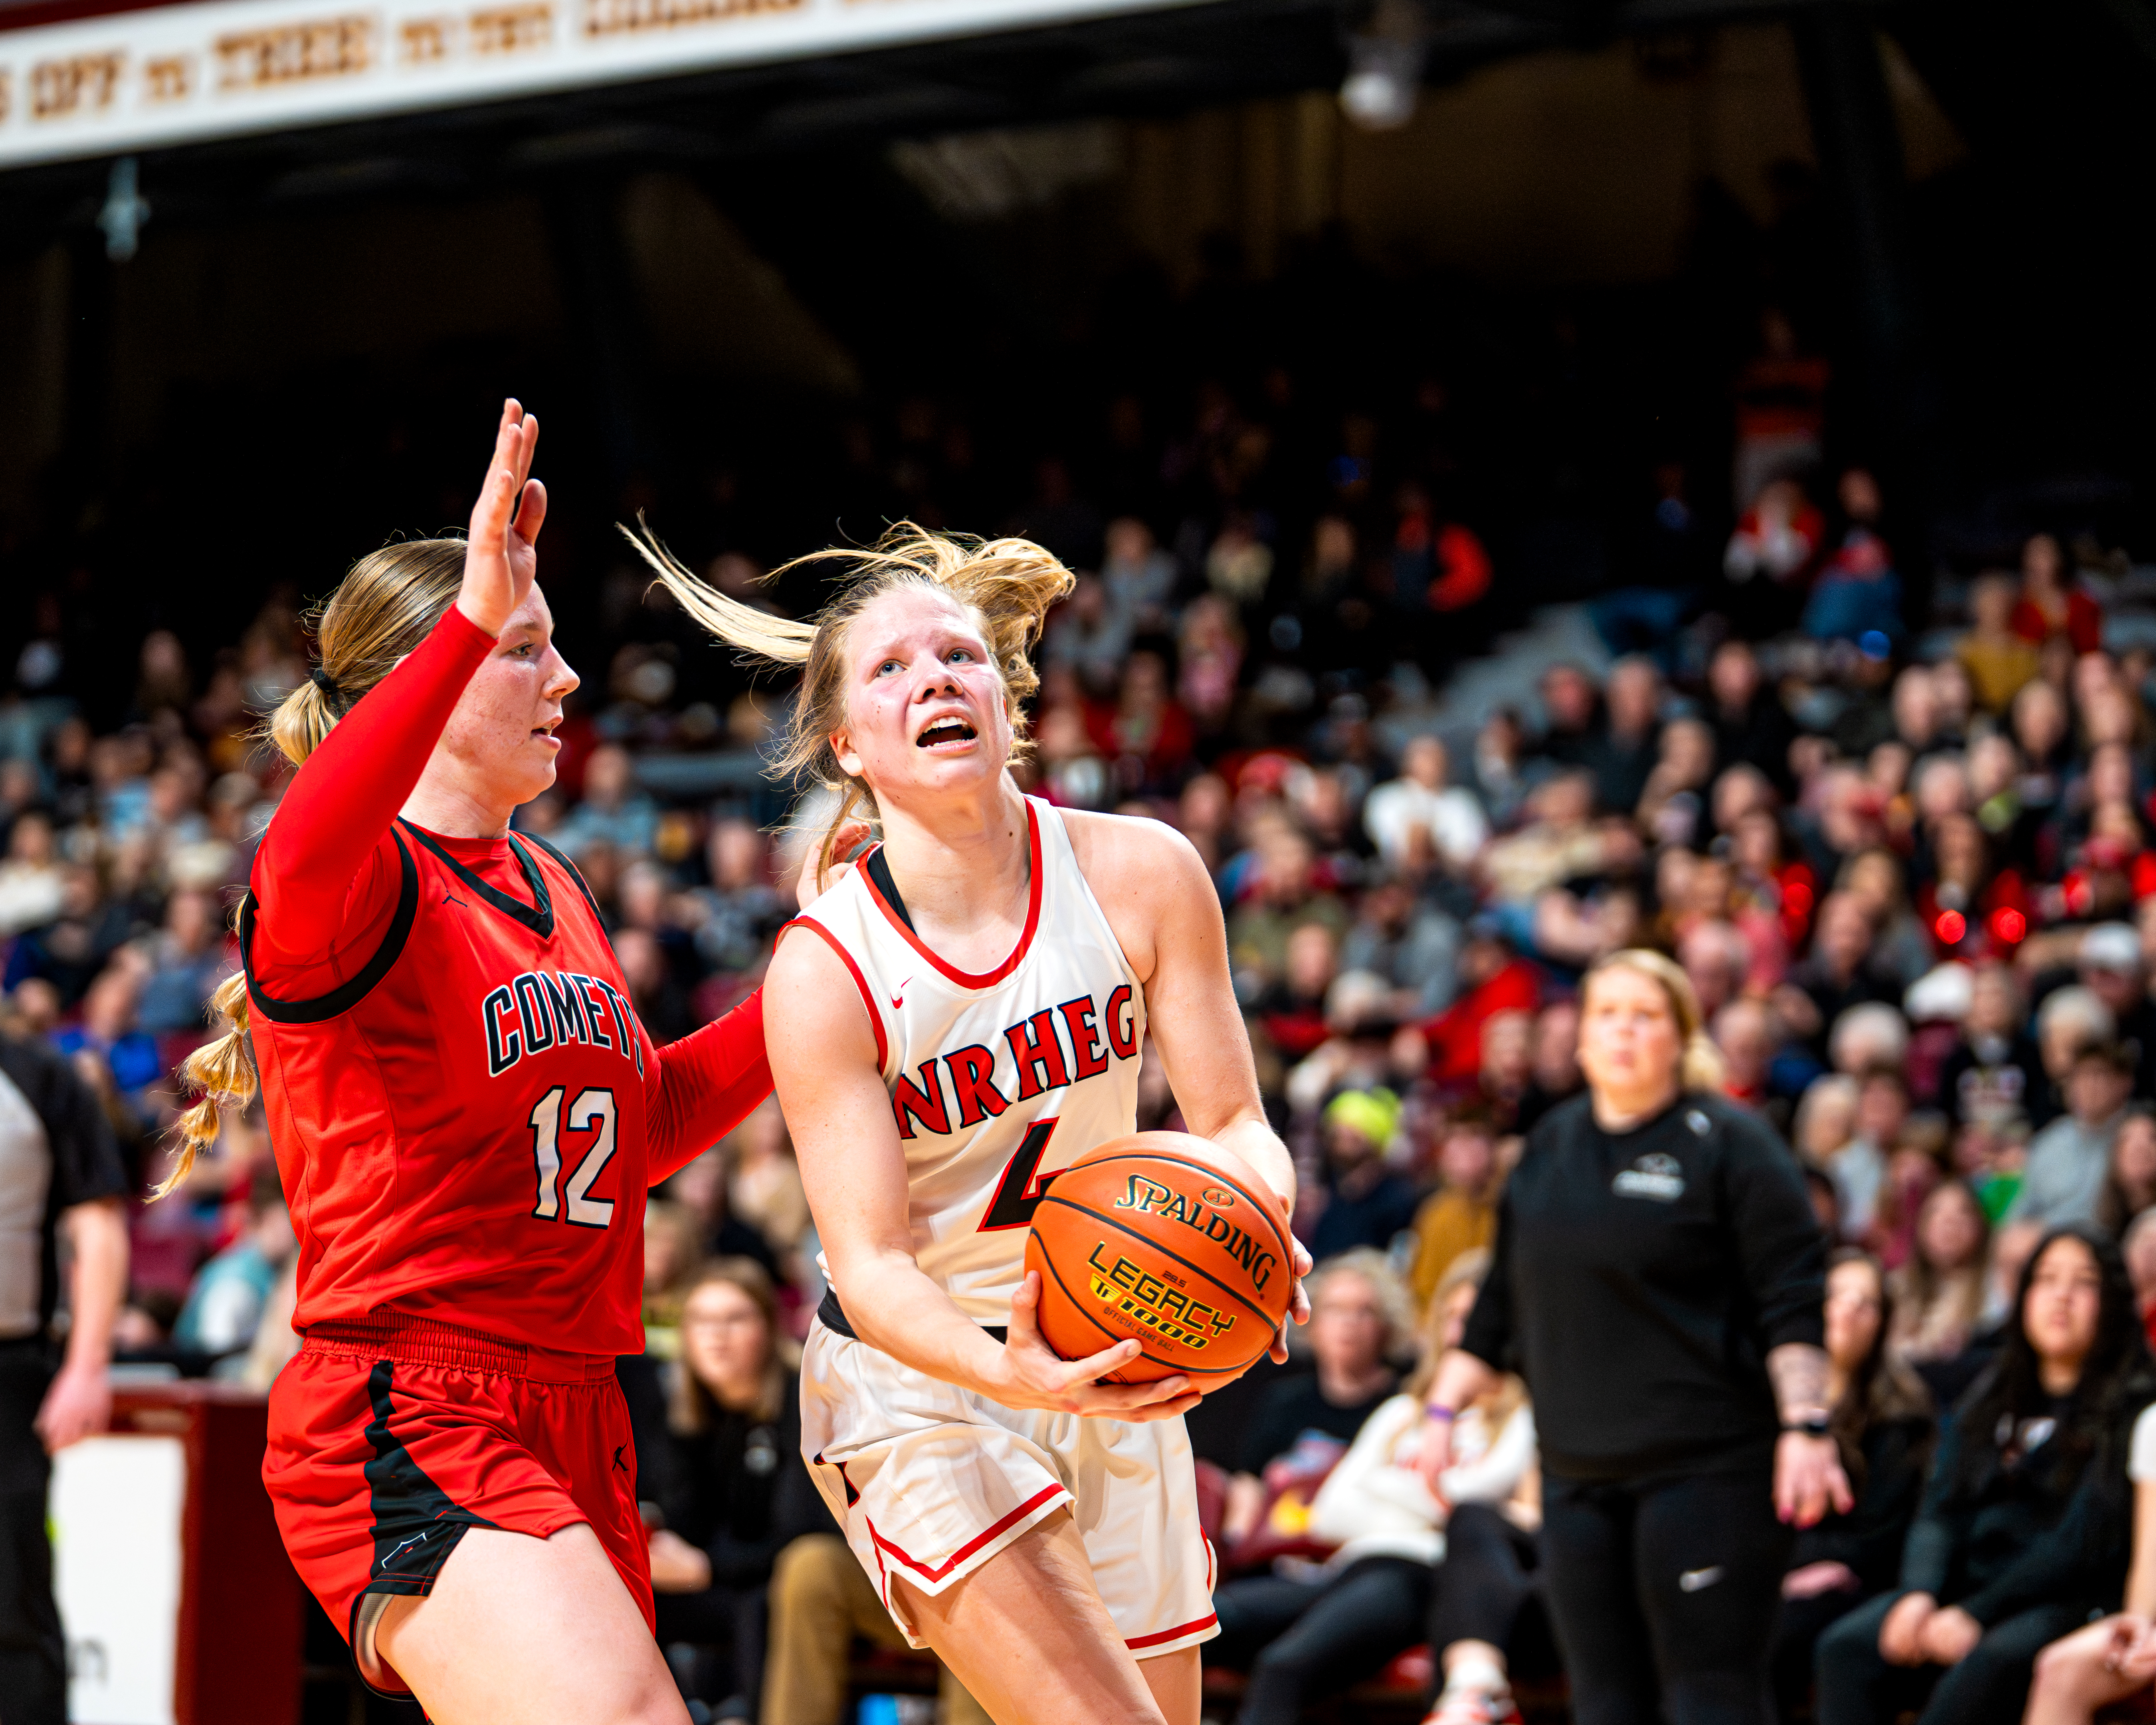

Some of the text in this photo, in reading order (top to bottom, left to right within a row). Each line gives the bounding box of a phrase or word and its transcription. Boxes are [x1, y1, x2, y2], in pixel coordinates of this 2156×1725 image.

[891, 984, 1137, 1140] NRHEG
[527, 1085, 619, 1230] 12
[1113, 1172, 1277, 1294] SPALDING
[1087, 1240, 1238, 1338] LEGACY
[1104, 1306, 1135, 1331] OFFICIAL
[1136, 1327, 1158, 1342] GAME
[1117, 1296, 1210, 1350] 1000
